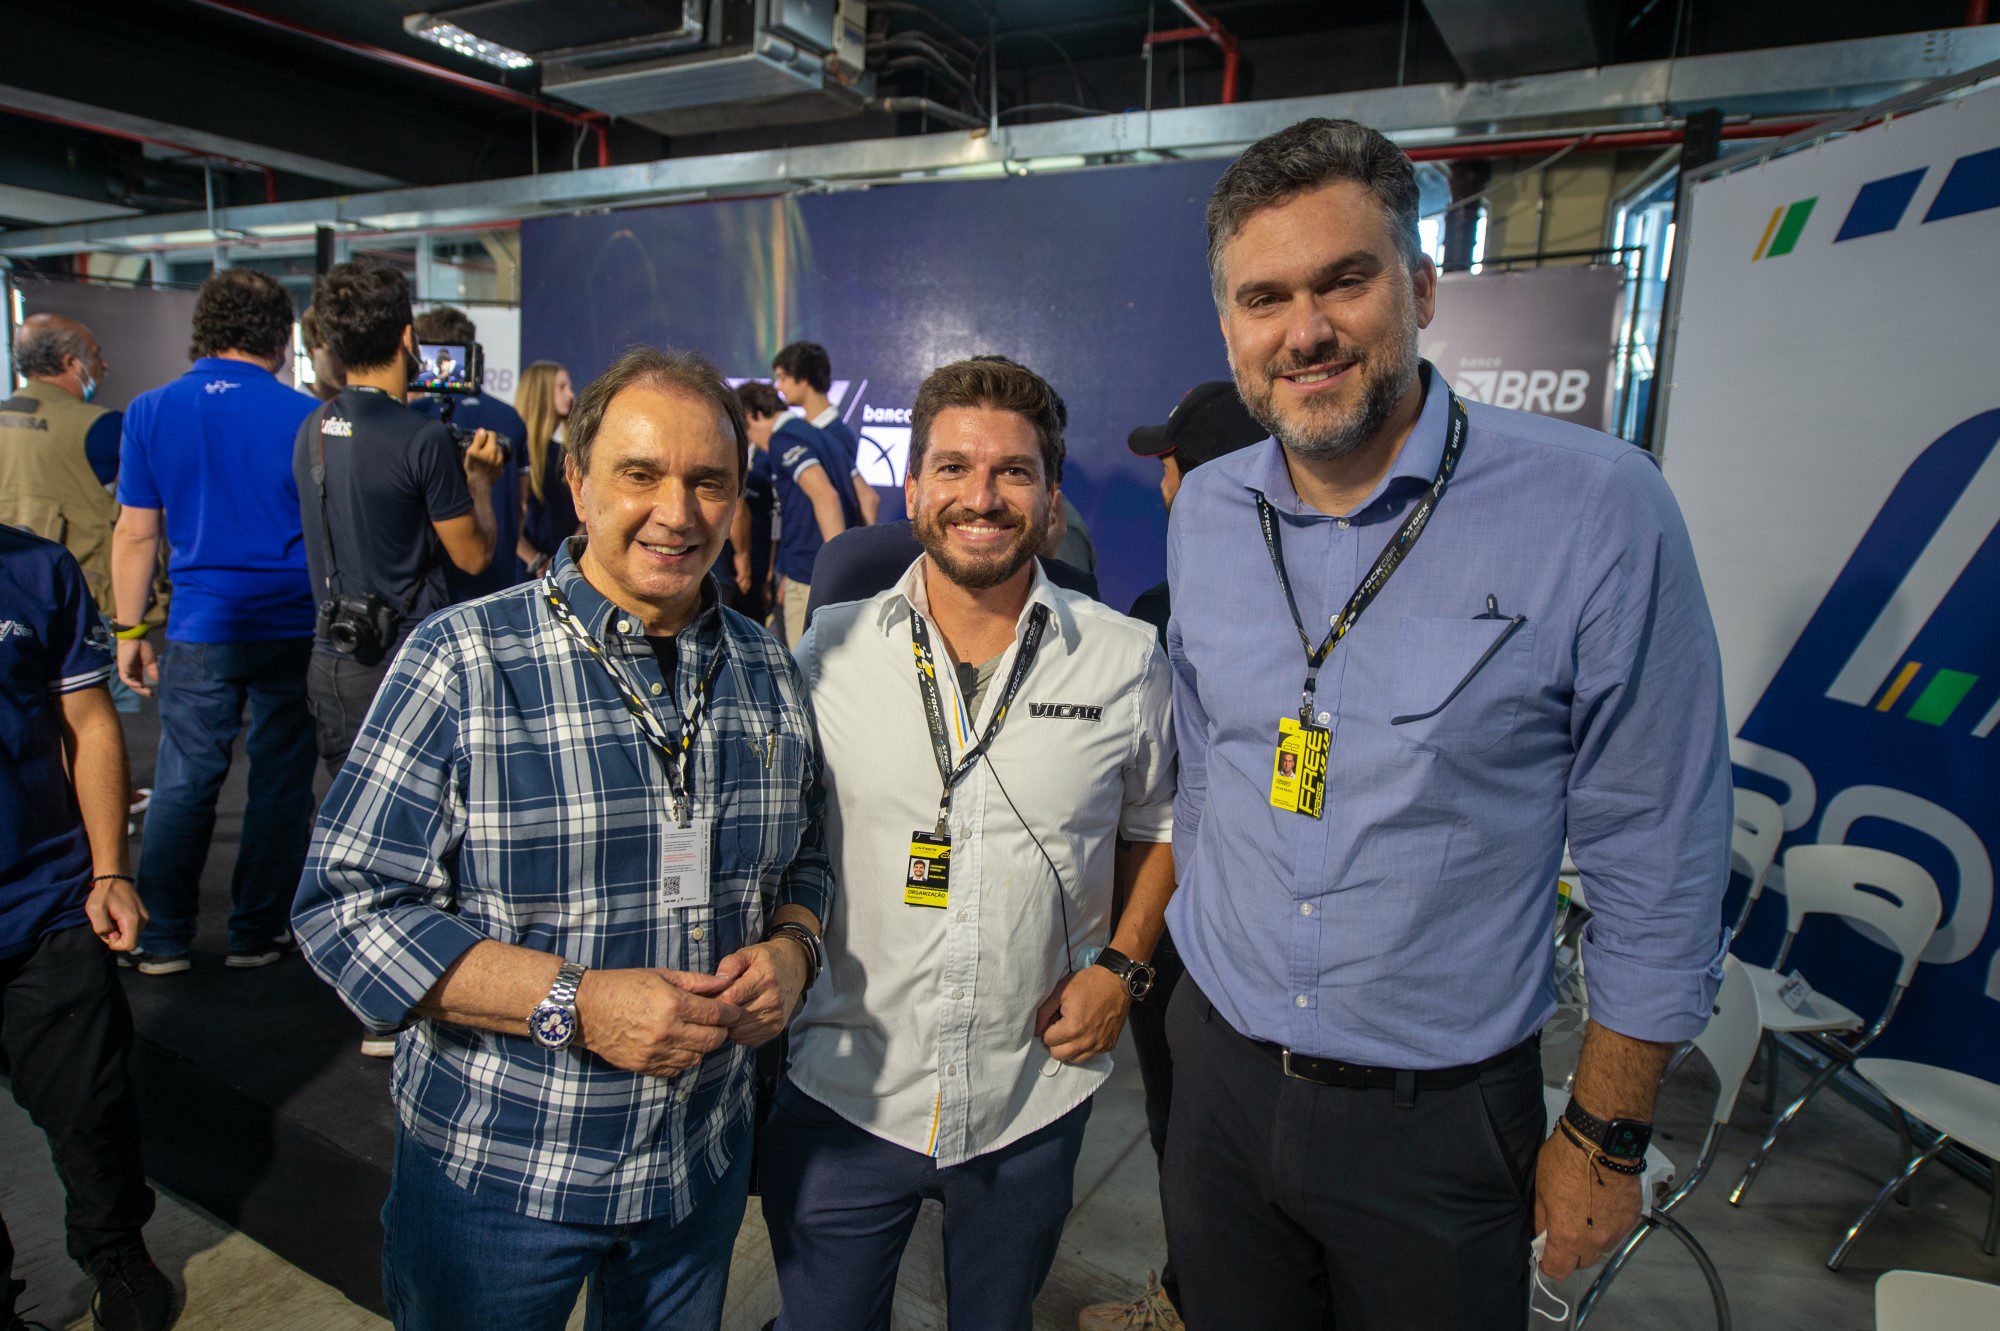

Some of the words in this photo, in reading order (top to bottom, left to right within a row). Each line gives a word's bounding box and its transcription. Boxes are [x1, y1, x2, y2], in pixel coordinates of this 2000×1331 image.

[484, 367, 513, 392] RB
[1495, 369, 1590, 413] BRB
[1367, 580, 1381, 596] PRO
[1382, 553, 1401, 578] SERIES
[1029, 702, 1104, 722] VICAR
[1299, 730, 1323, 815] FREE
